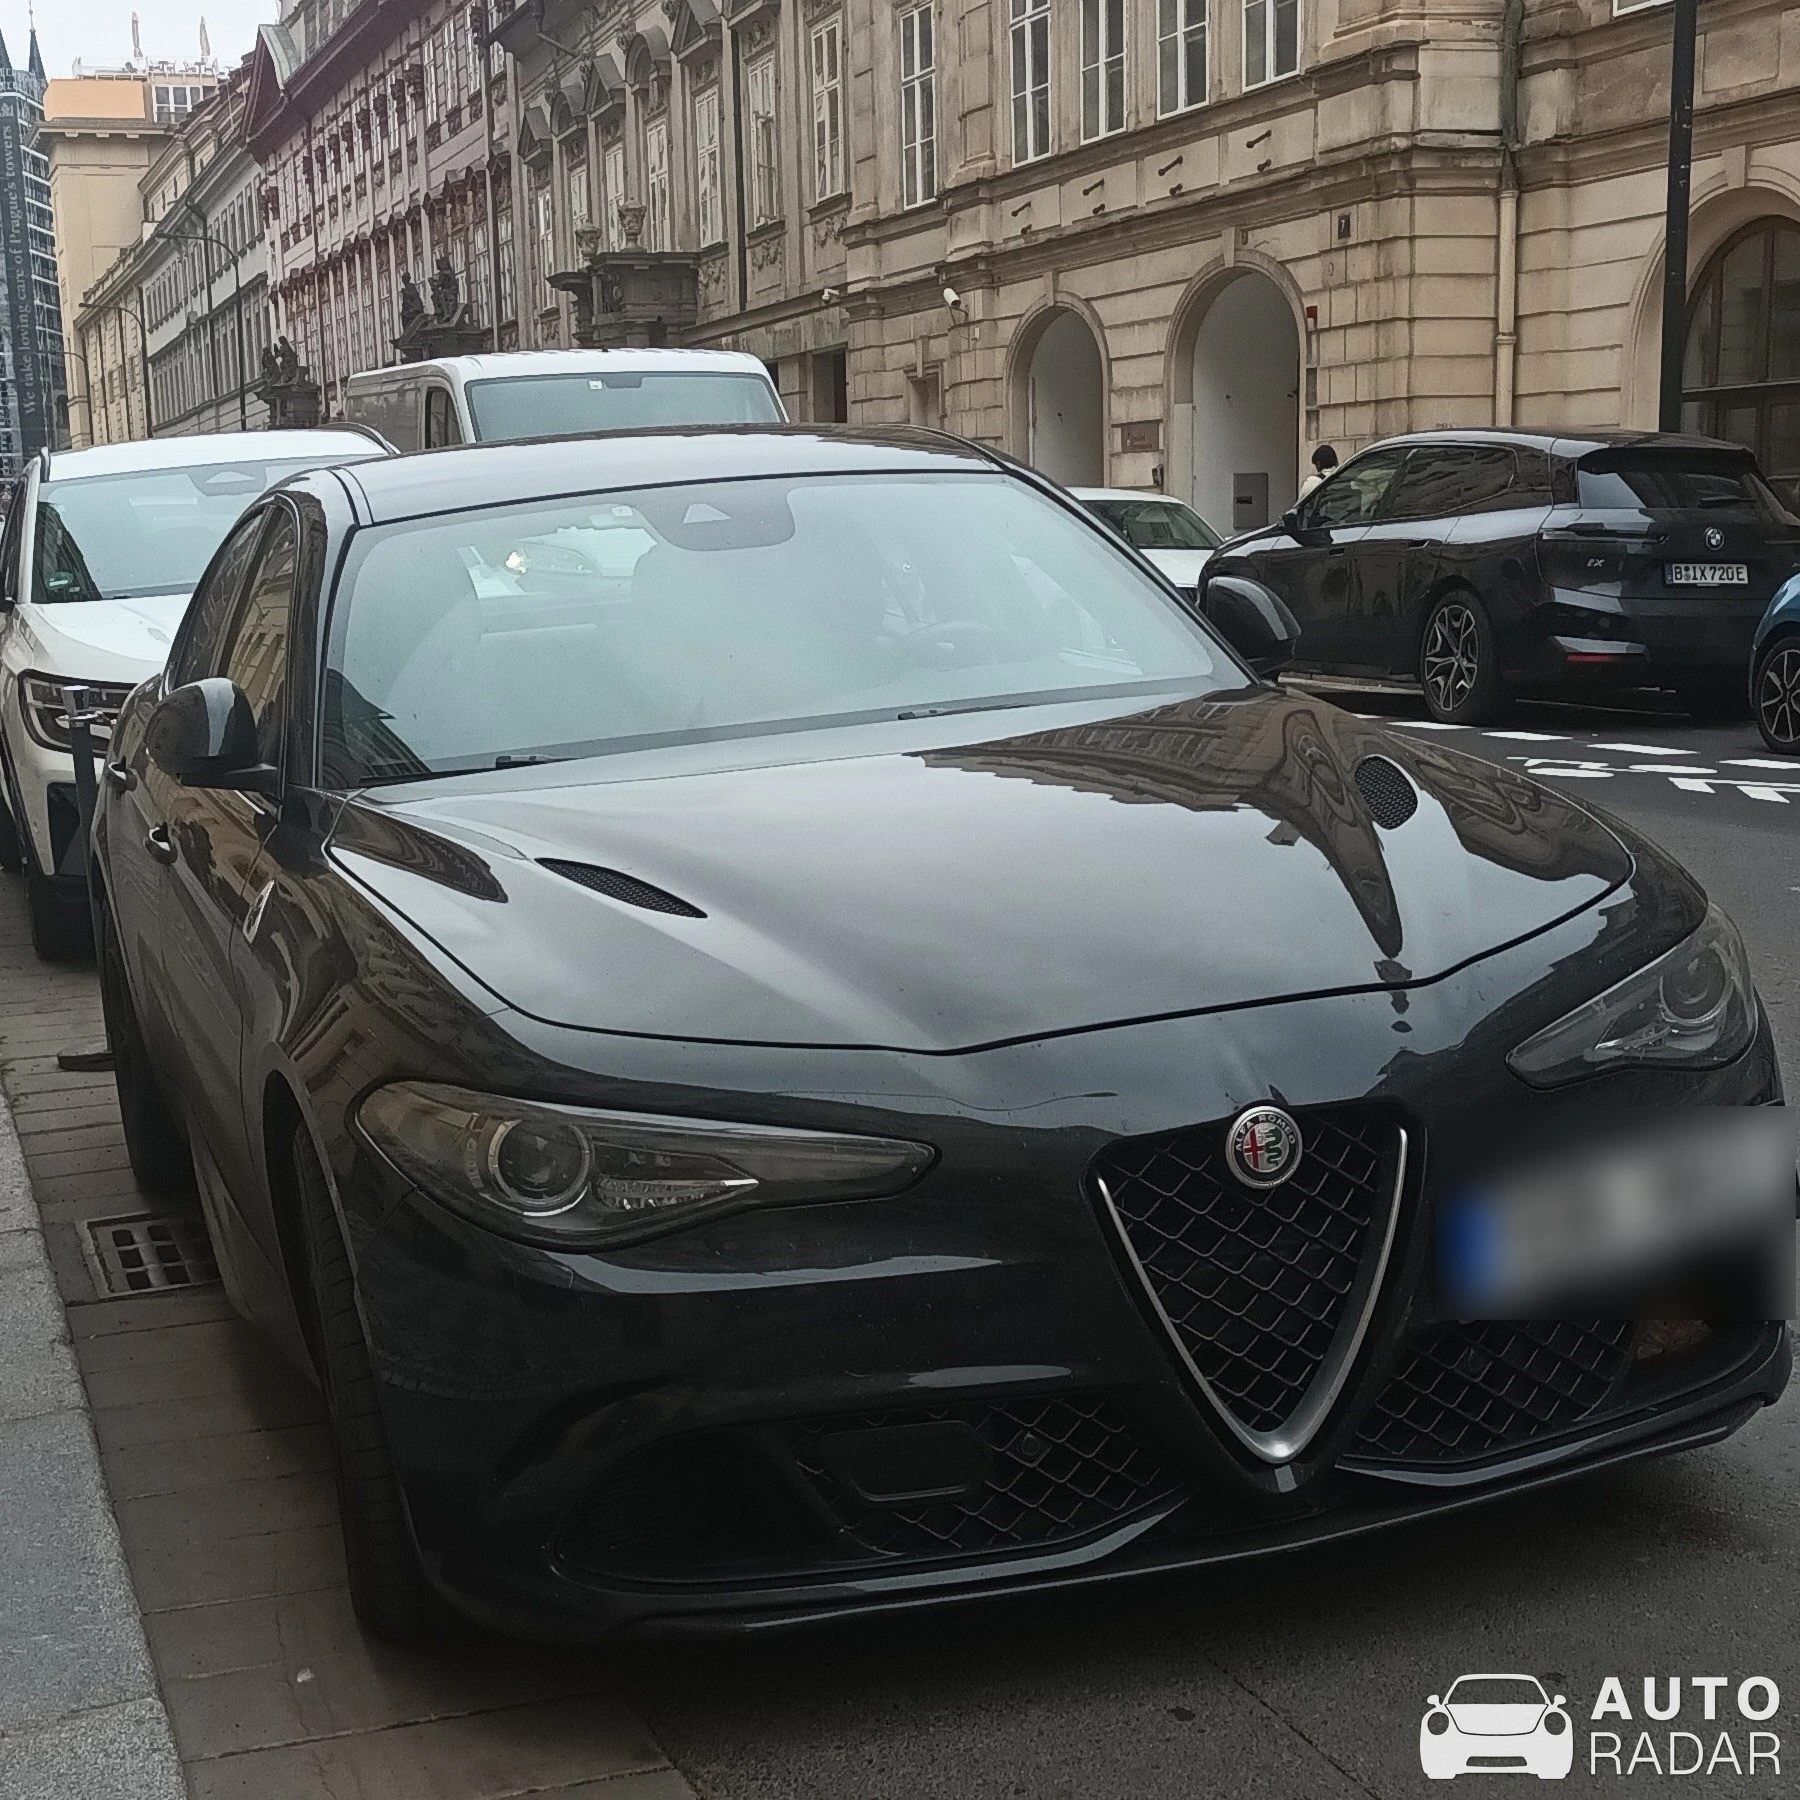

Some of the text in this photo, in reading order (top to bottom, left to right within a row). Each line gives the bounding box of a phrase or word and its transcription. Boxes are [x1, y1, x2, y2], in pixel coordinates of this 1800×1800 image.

[3, 125, 36, 415] We take loving care of Prague's towers
[1235, 1114, 1296, 1152] ALFA ROMEO
